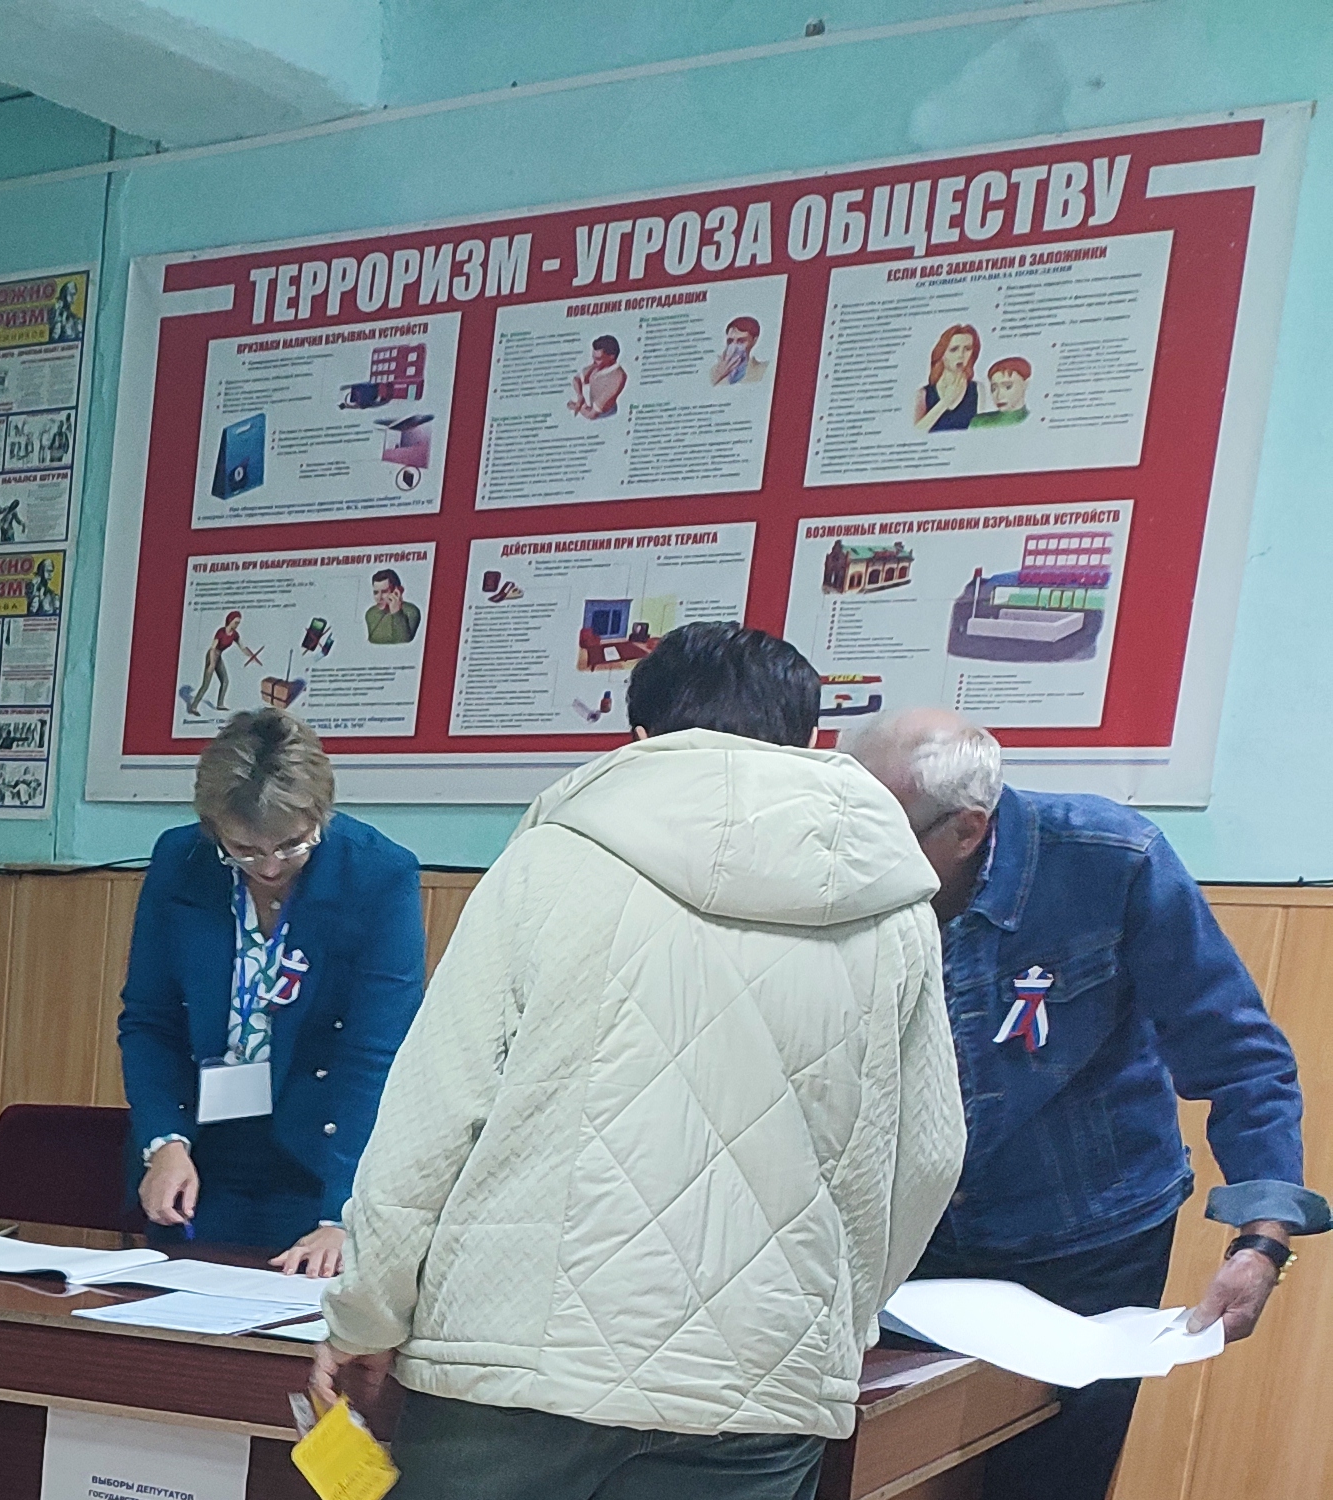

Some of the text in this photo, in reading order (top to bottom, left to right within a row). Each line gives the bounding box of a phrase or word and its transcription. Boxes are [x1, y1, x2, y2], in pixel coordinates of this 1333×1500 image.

[249, 232, 533, 325] ТЕРРОРИЗМ
[572, 201, 772, 287] УГРОЗА
[787, 154, 1131, 262] ОБЩЕСТВУ
[887, 266, 917, 282] ЕСЛИ
[919, 263, 943, 279] ВАС
[946, 255, 1016, 277] ЗАХВАТИЛИ
[1030, 245, 1107, 266] ЗАЛОЖНИКИ
[566, 290, 707, 318] ПОВЕДЕНИЕ ПОСТРАДАВШИХ
[237, 322, 428, 354] ПРИЗНАКИ НАЛИЧИЯ ВЗРЫВНЫХ УСТРОЙСТВ
[805, 508, 1120, 540] ВОЗМОЖНЫЕ МЕСТА УСТАНОВКИ ВЗРЫВНЫХ УСТРОЙСТВ
[501, 531, 718, 558] ДЕЙСТВИЯ НАСЕЛЕНИЯ ПРИ УГРОЗЕ ТЕРАКТА
[192, 550, 428, 573] ЧТО ДЕЛАТЬ ПРИ ОБНАРУЖЕНИИ ВЗРЫВНОГО УСТРОЙСТВА
[91, 1475, 134, 1491] ВЫБОРЫ
